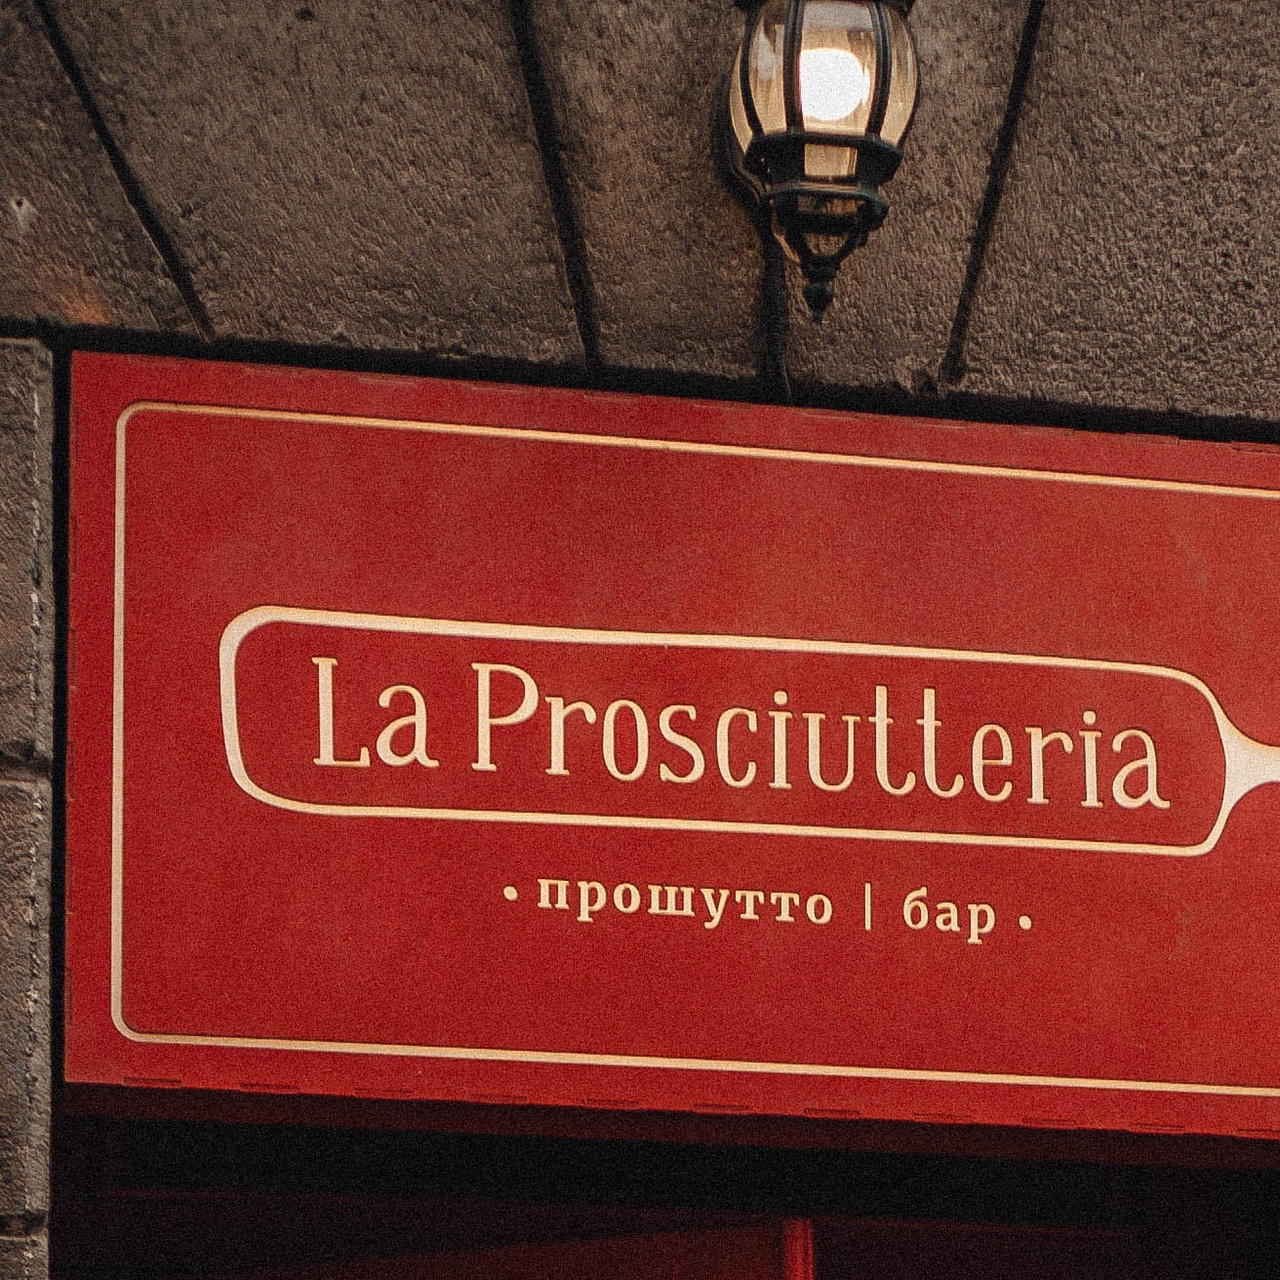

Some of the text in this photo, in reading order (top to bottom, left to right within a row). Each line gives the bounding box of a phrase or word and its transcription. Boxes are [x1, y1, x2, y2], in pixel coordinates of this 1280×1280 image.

[311, 657, 1171, 811] La Prosciutteria
[537, 878, 996, 945] прошутто бар
